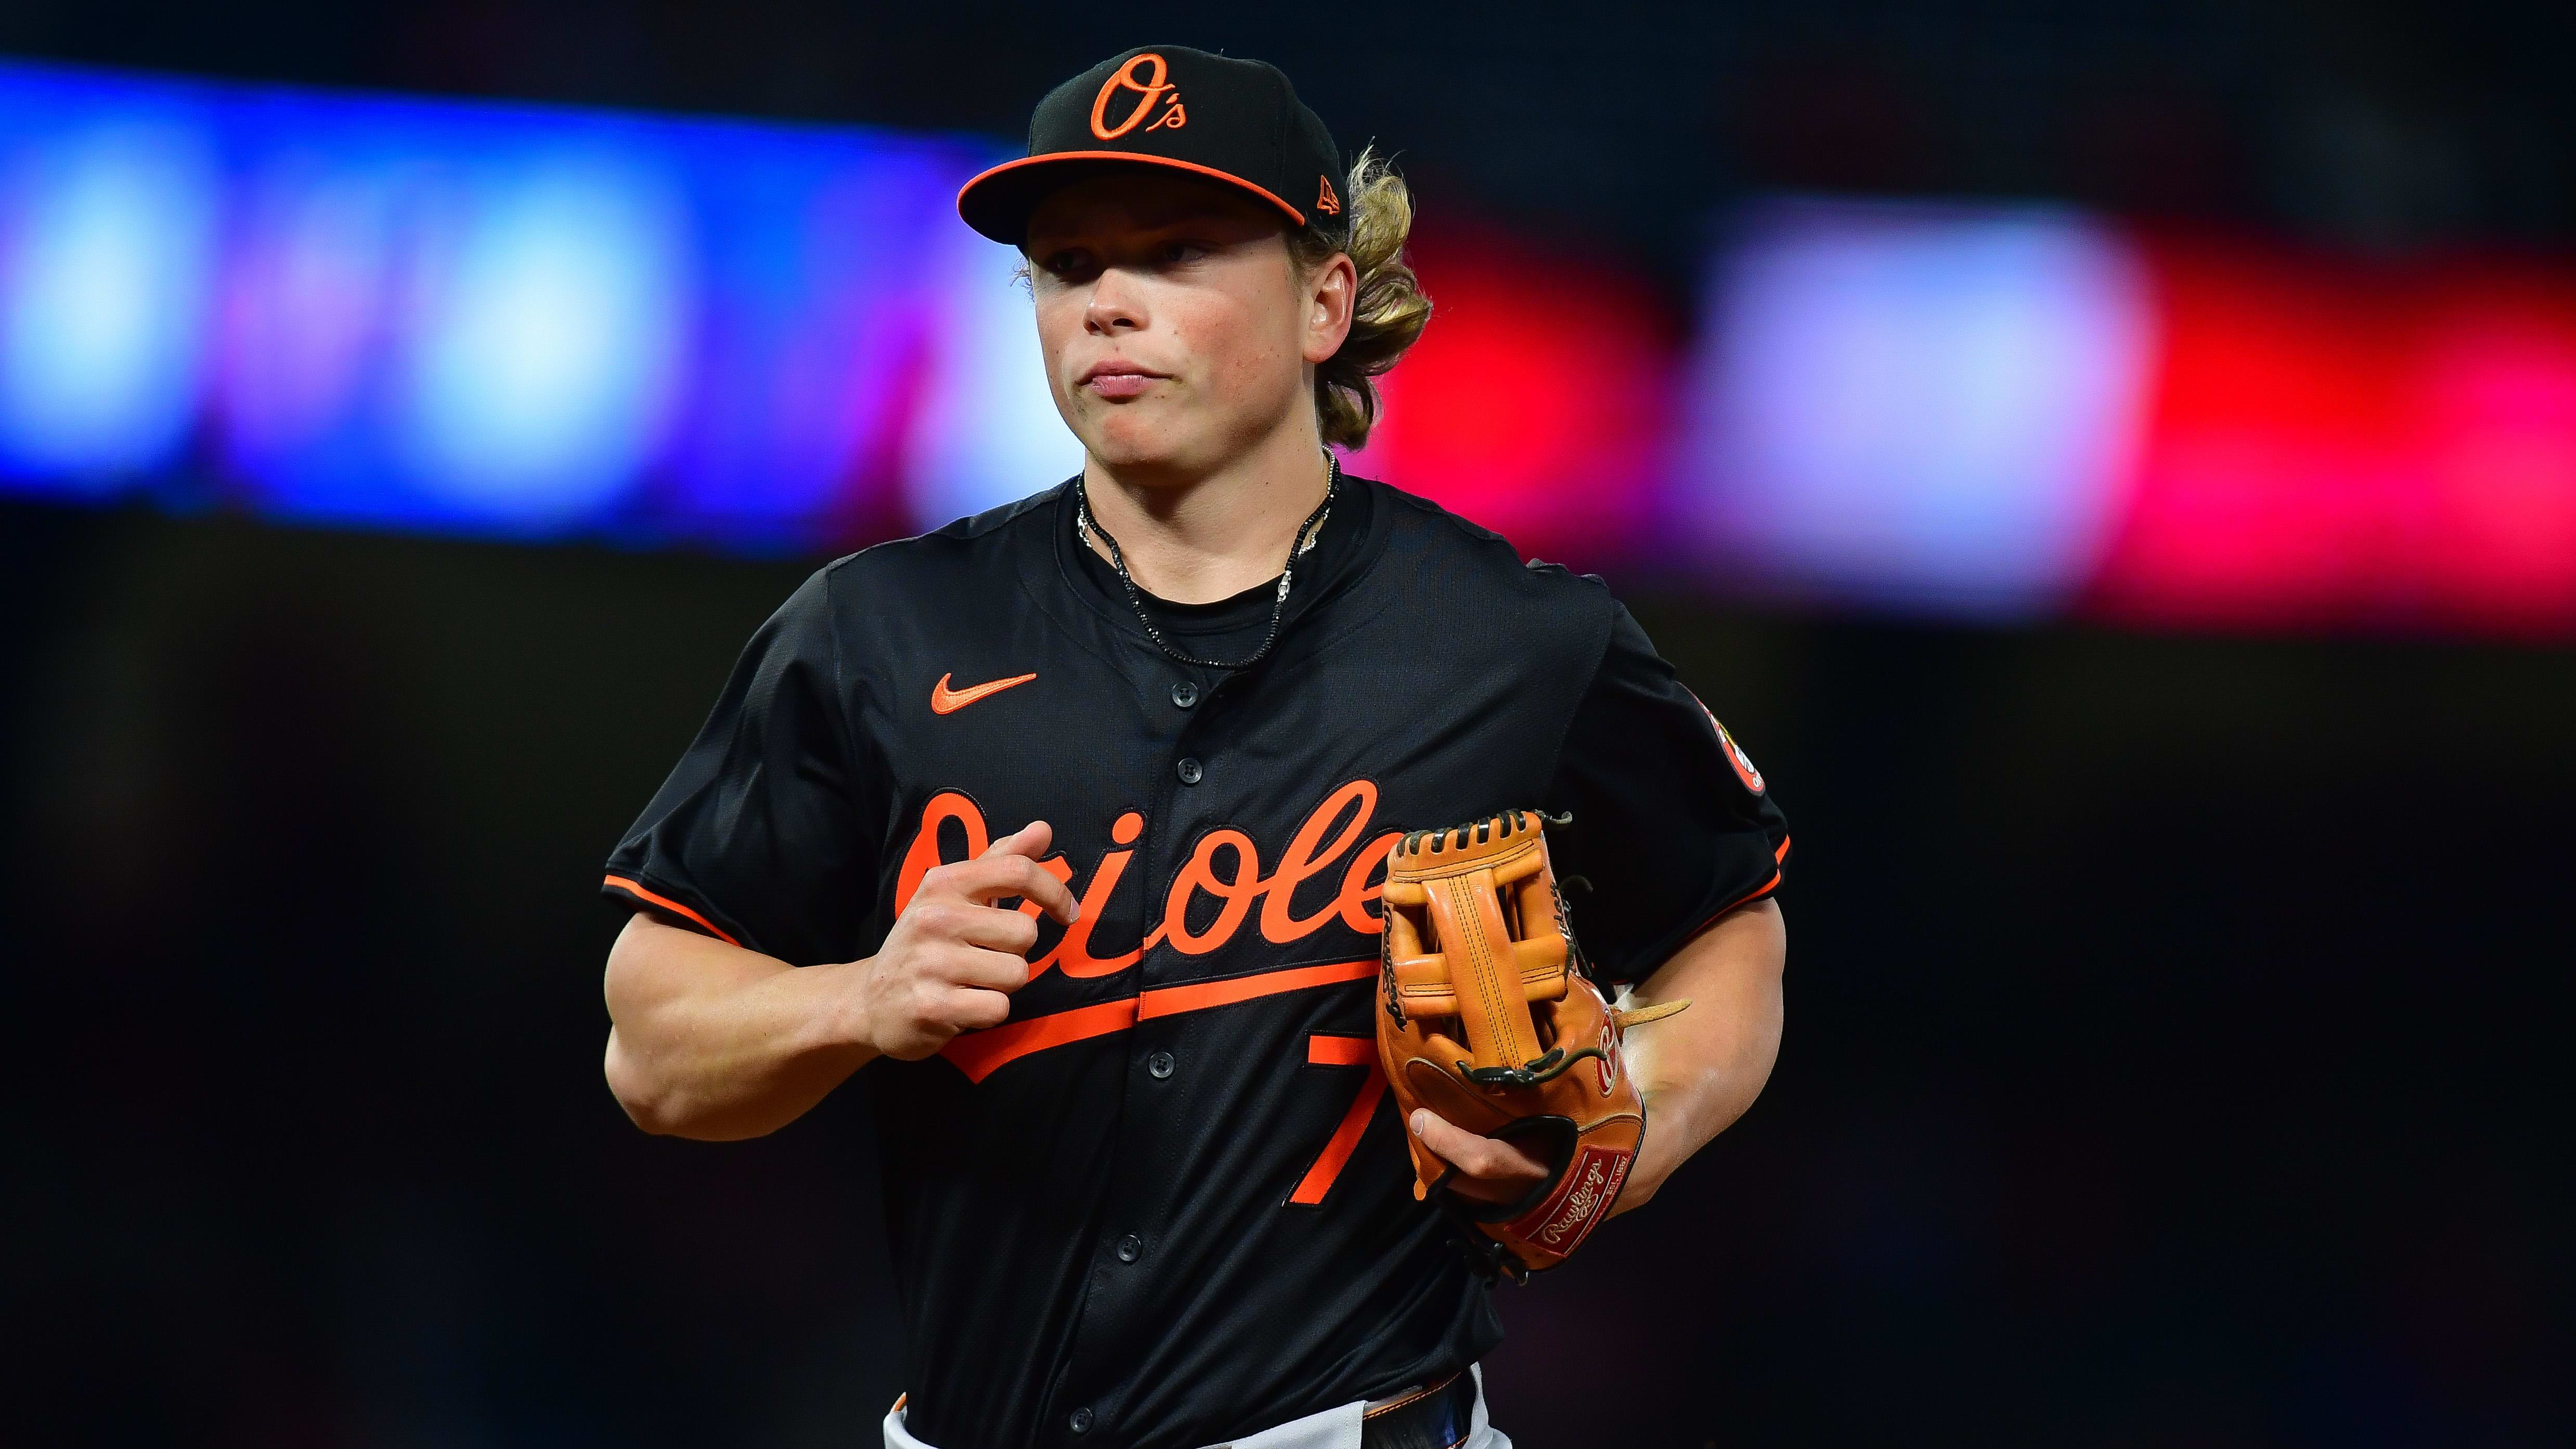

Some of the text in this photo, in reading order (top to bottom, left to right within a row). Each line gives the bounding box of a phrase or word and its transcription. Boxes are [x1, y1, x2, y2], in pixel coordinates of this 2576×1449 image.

[1091, 53, 1186, 140] O's
[895, 780, 1407, 983] Oiole
[1290, 1035, 1389, 1205] 7
[1543, 1158, 1604, 1241] Rawlings
